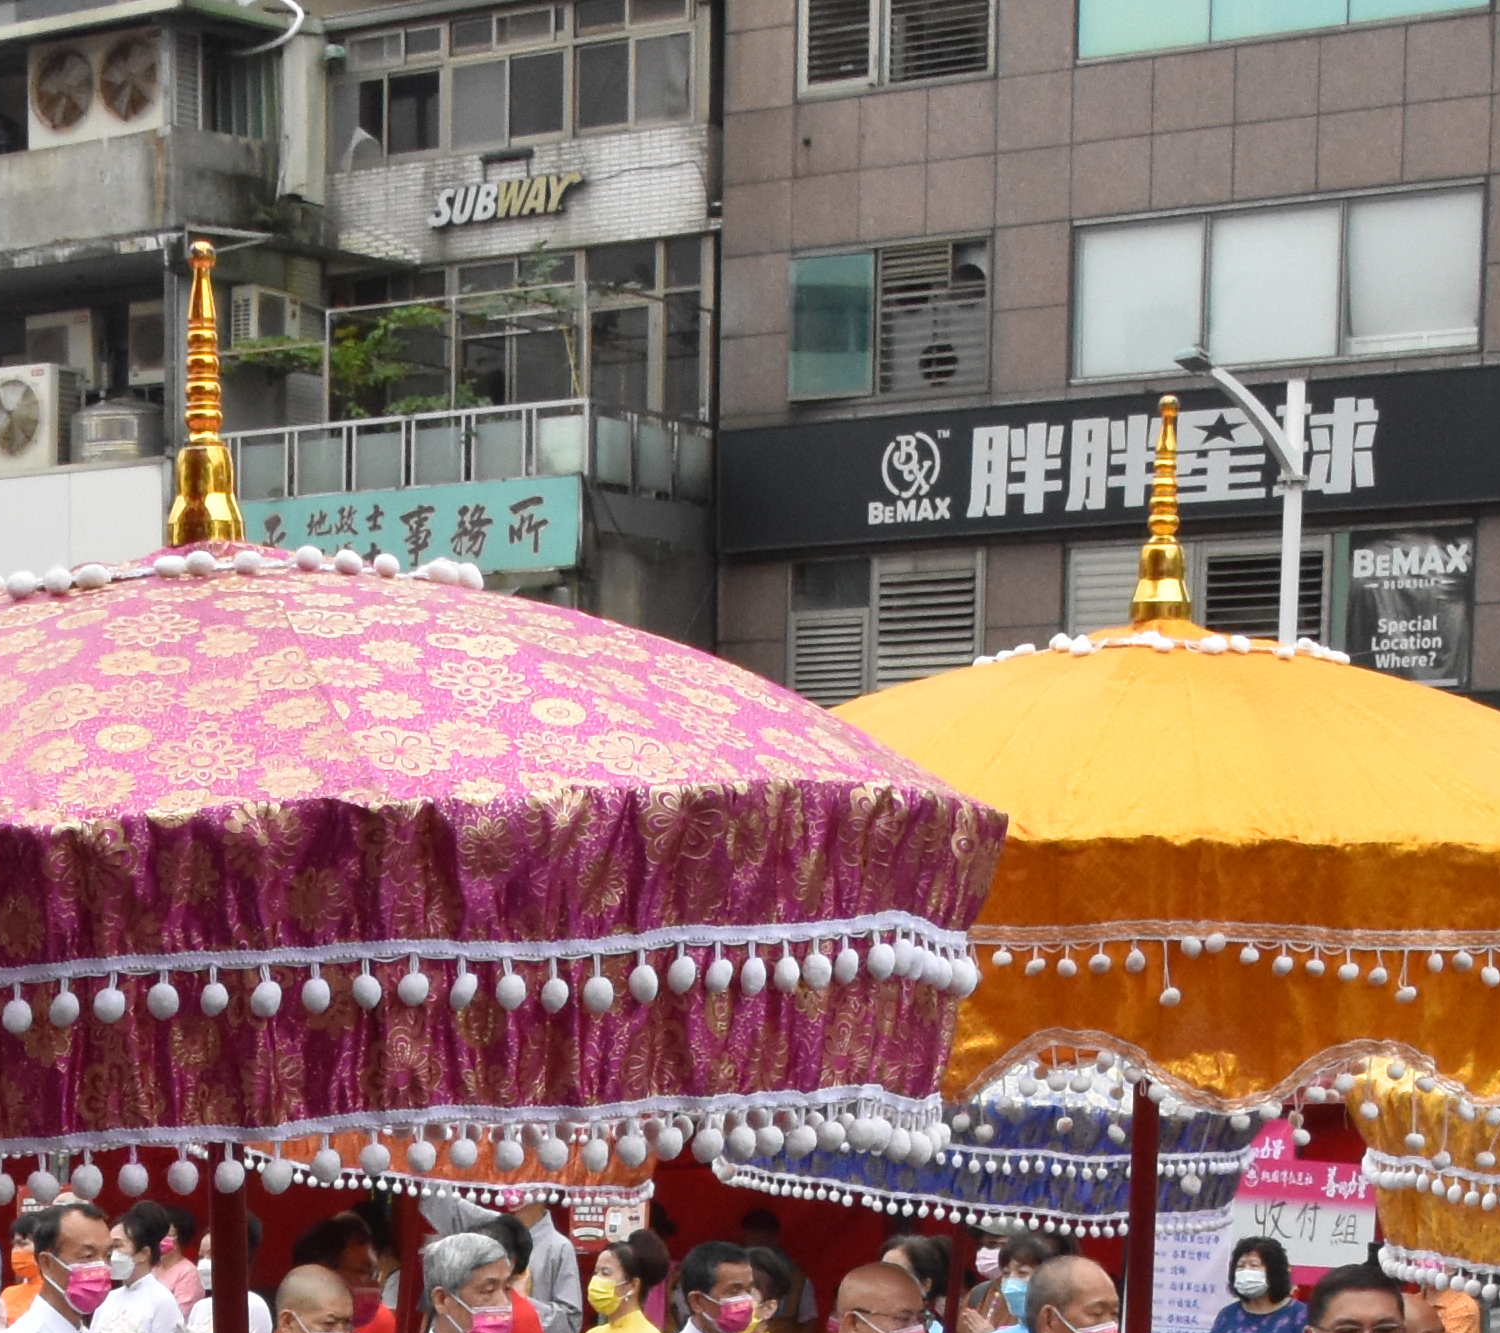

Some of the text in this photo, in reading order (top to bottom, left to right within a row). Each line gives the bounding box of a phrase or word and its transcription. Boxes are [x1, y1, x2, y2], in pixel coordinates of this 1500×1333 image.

[428, 170, 585, 229] SUBWAY
[967, 397, 1379, 518] 胖胖星球
[399, 495, 549, 568] 事務所
[1371, 633, 1443, 651] Location
[1377, 615, 1438, 636] Special
[1374, 651, 1437, 669] Where?
